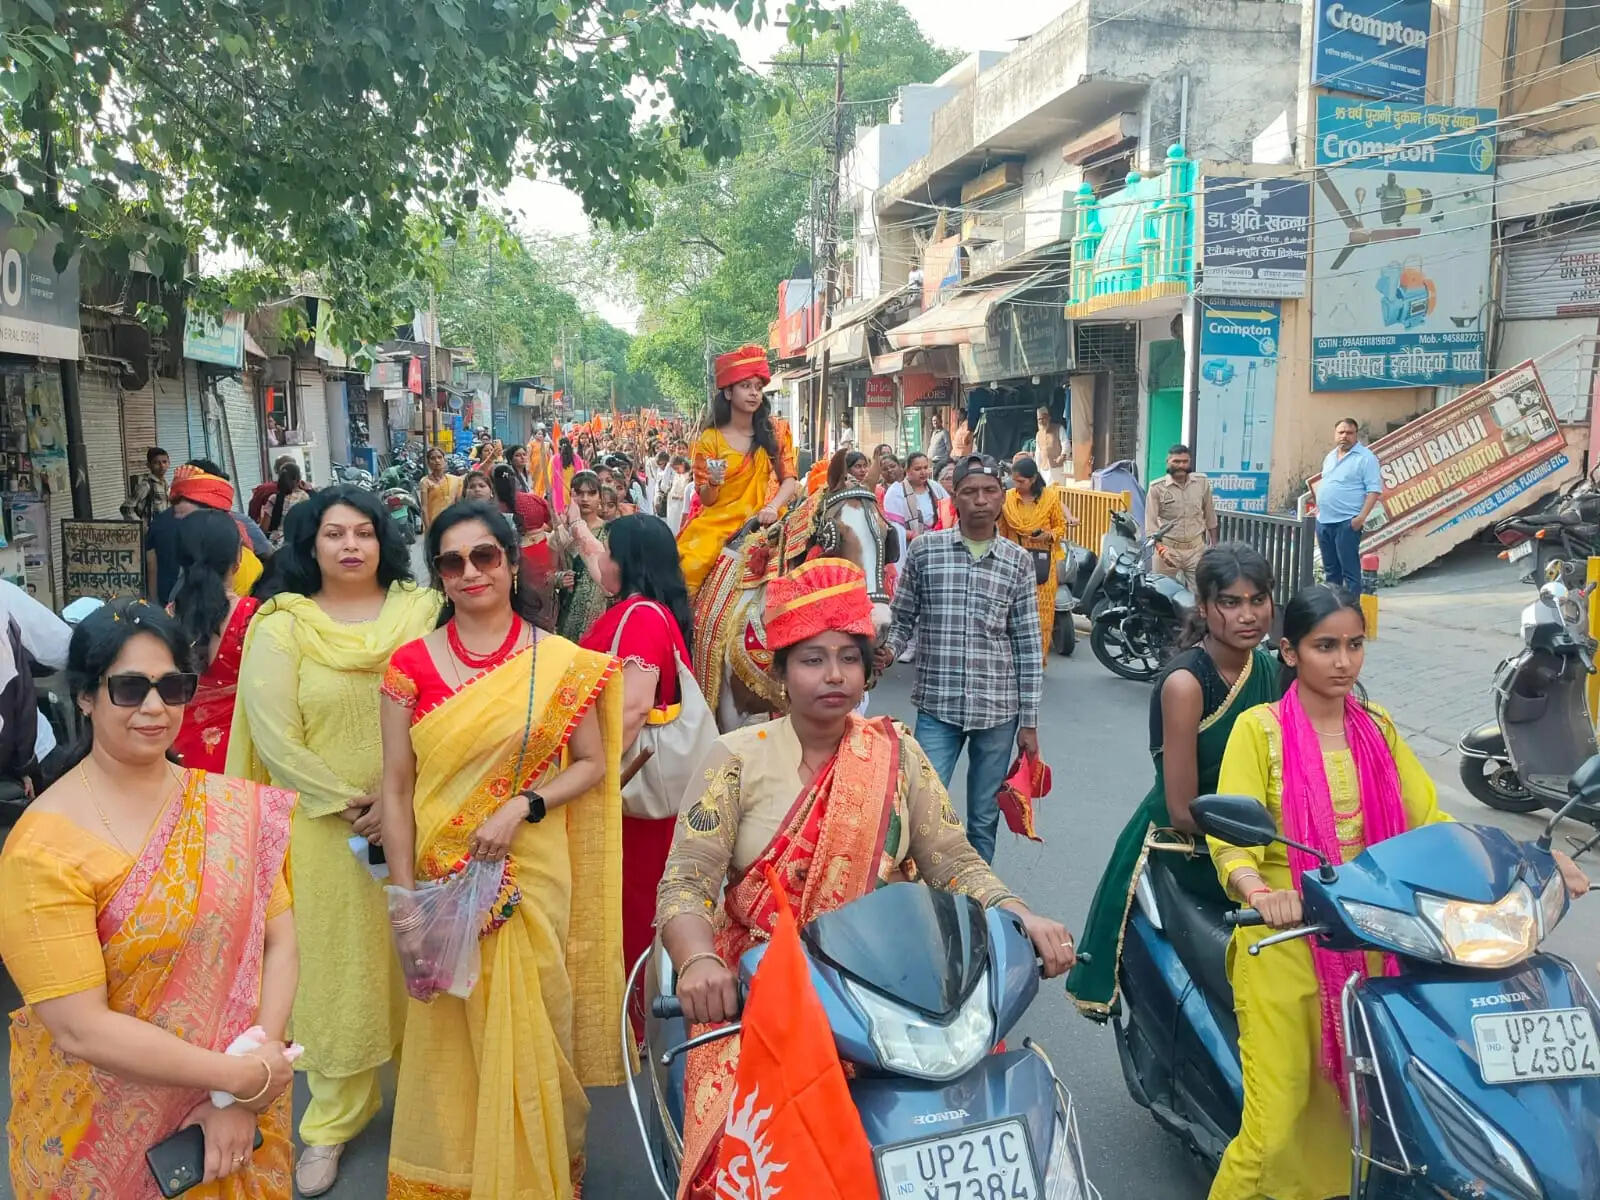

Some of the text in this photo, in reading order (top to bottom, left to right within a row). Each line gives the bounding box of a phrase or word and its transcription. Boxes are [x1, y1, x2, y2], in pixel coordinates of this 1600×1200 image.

[1326, 3, 1427, 48] Crompton
[1323, 134, 1436, 166] Crompton
[0, 248, 22, 306] O
[1209, 322, 1271, 338] Crompton
[1318, 338, 1338, 348] GSTIN
[1380, 448, 1430, 489] SHRI
[1424, 414, 1489, 466] BALAJI
[1386, 476, 1441, 517] INTERIOR
[1438, 441, 1504, 490] DECORATOR
[1519, 461, 1552, 489] FLOORING
[1470, 991, 1531, 1009] HONDA
[1505, 1013, 1587, 1045] UP21C
[1512, 1044, 1596, 1077] L4504
[911, 1108, 971, 1125] HONDA
[916, 1131, 1019, 1182] UP21C
